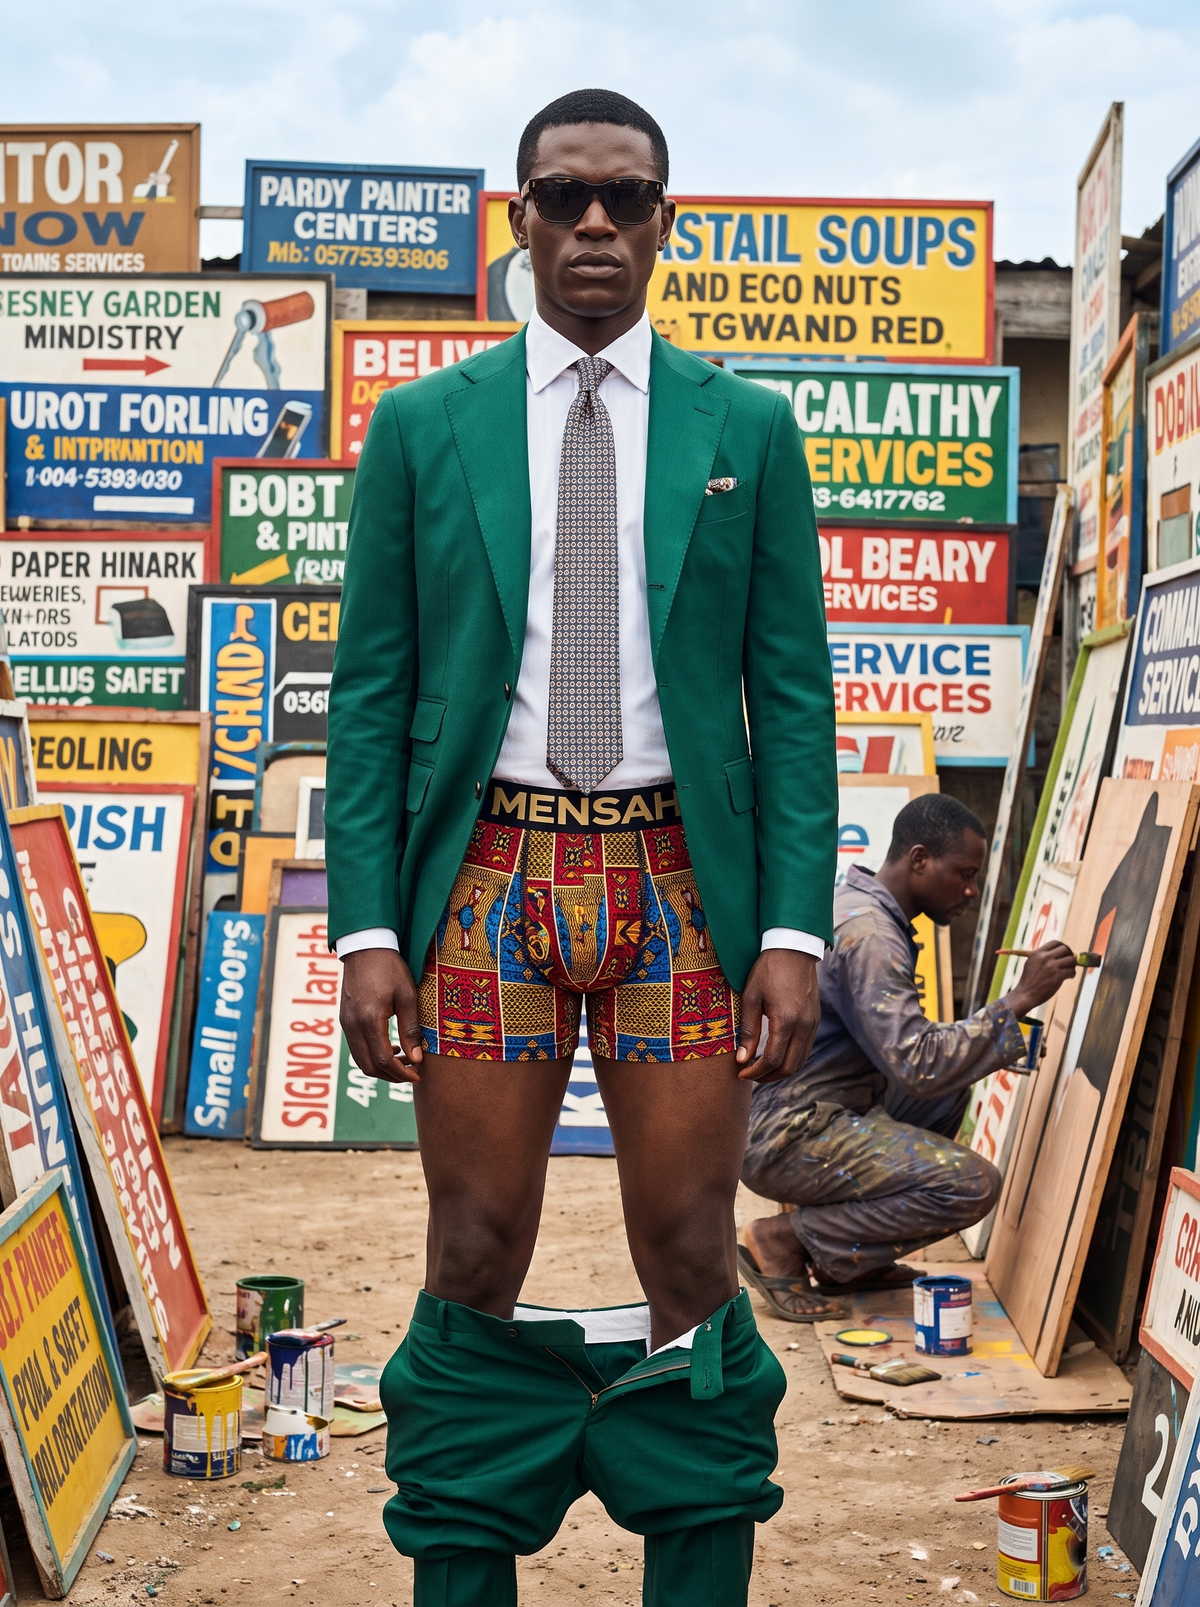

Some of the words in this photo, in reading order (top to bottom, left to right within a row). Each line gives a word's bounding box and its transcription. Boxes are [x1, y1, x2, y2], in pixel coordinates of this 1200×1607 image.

[260, 176, 352, 209] PARDY
[361, 180, 471, 214] PAINTER
[294, 211, 438, 244] CENTERS
[658, 212, 802, 265] STAIL
[816, 215, 976, 271] SOUPS
[65, 254, 145, 272] SERVICES
[0, 290, 94, 318] ESNEY
[103, 291, 221, 318] GARDEN
[662, 272, 729, 302] AND
[740, 273, 803, 304] ECO
[813, 275, 902, 306] NUTS
[24, 325, 184, 350] MINDISTRY
[10, 390, 107, 431] UROT
[119, 393, 269, 437] FORLING
[25, 434, 45, 460] &
[229, 474, 344, 518] BOBT
[256, 521, 281, 551] &
[11, 551, 91, 577] PAPER
[101, 552, 196, 578] HINARK
[861, 536, 996, 583] BEARY
[491, 786, 682, 826] MENSAH
[290, 1017, 335, 1037] &
[194, 1025, 239, 1130] Small
[281, 1042, 334, 1129] SIGNO
[43, 1336, 61, 1390] &
